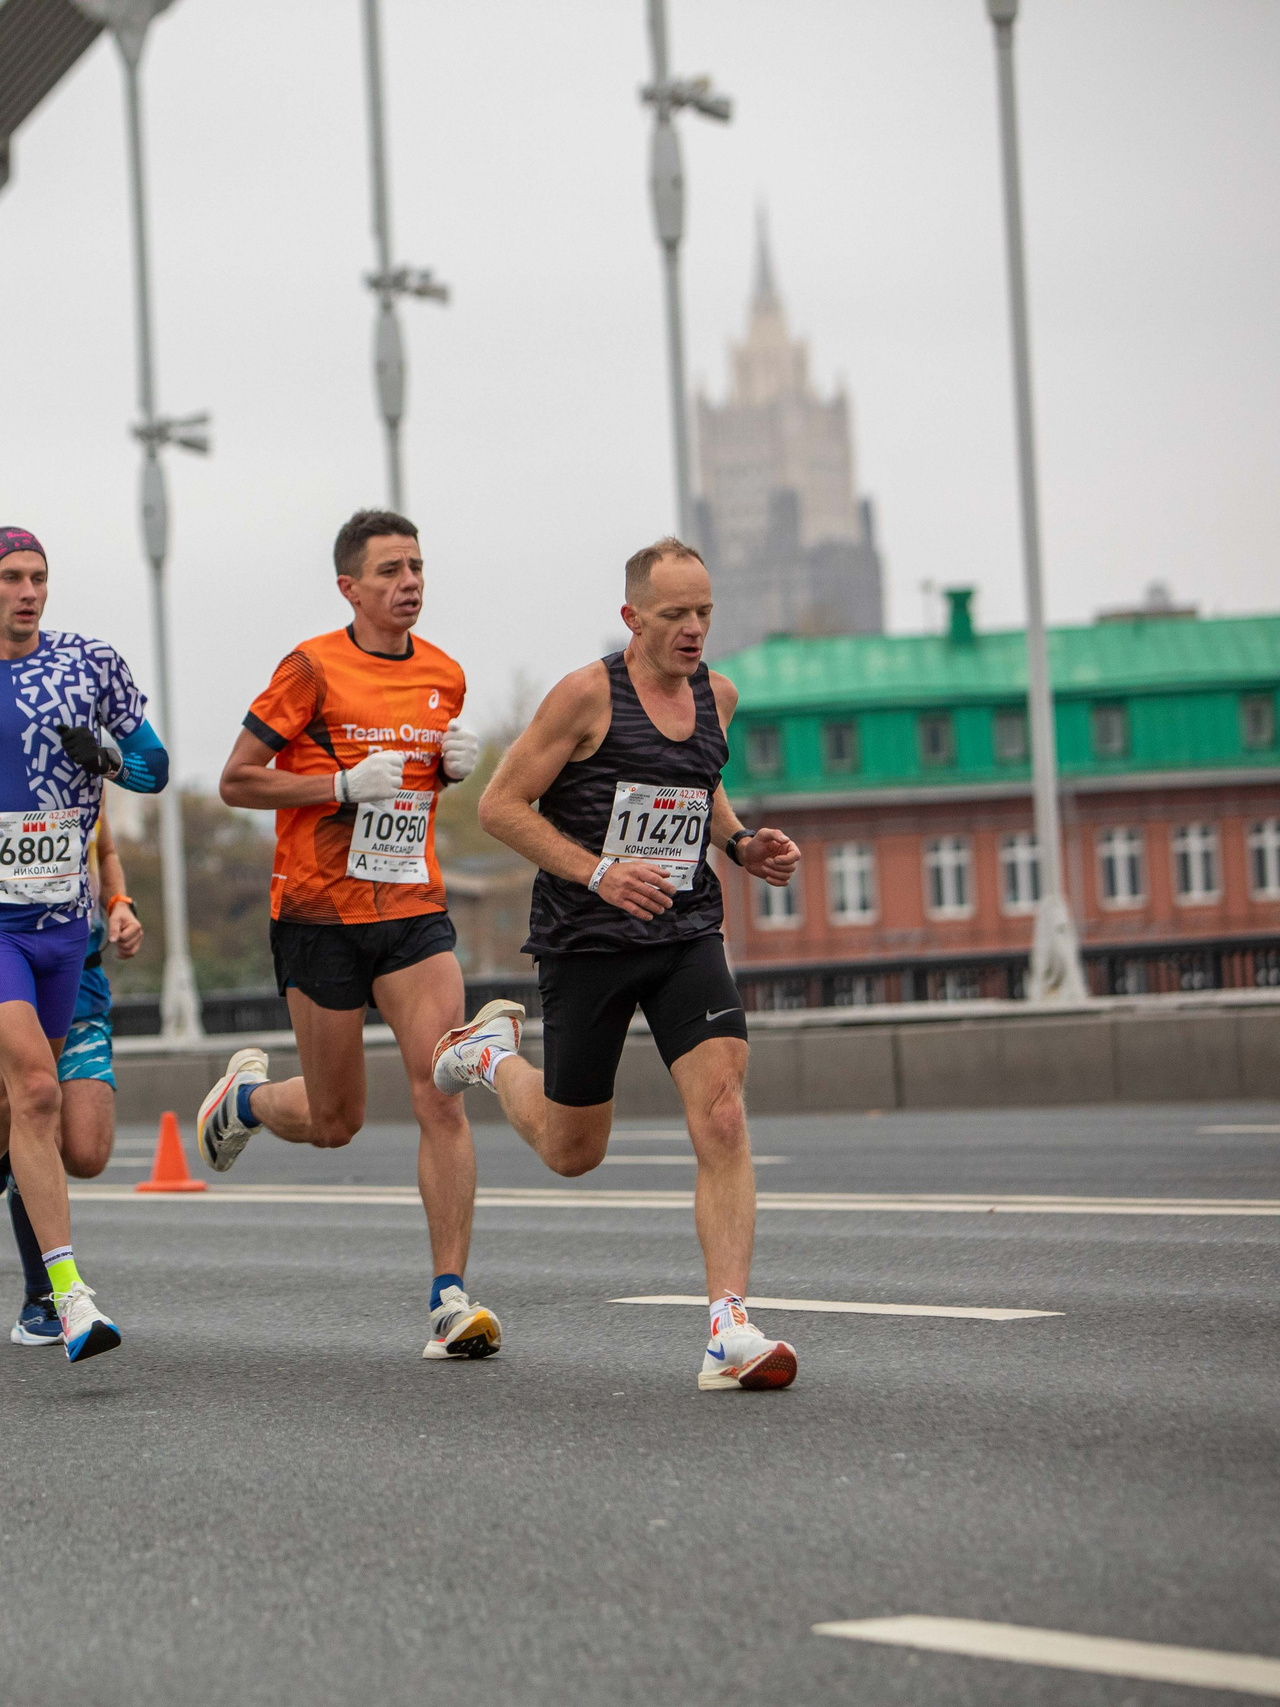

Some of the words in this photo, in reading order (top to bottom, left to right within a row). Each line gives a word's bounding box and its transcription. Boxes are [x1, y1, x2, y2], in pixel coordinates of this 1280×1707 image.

[341, 724, 396, 741] Team
[400, 723, 443, 748] Orang
[679, 789, 695, 799] 42,2
[49, 811, 66, 820] 42,2
[362, 811, 427, 842] 10950
[617, 810, 702, 845] 11470
[371, 842, 414, 854] АЛЕКСАНДР
[624, 845, 682, 857] КОНСТАНТИН
[13, 865, 59, 876] НИКОЛАЙ
